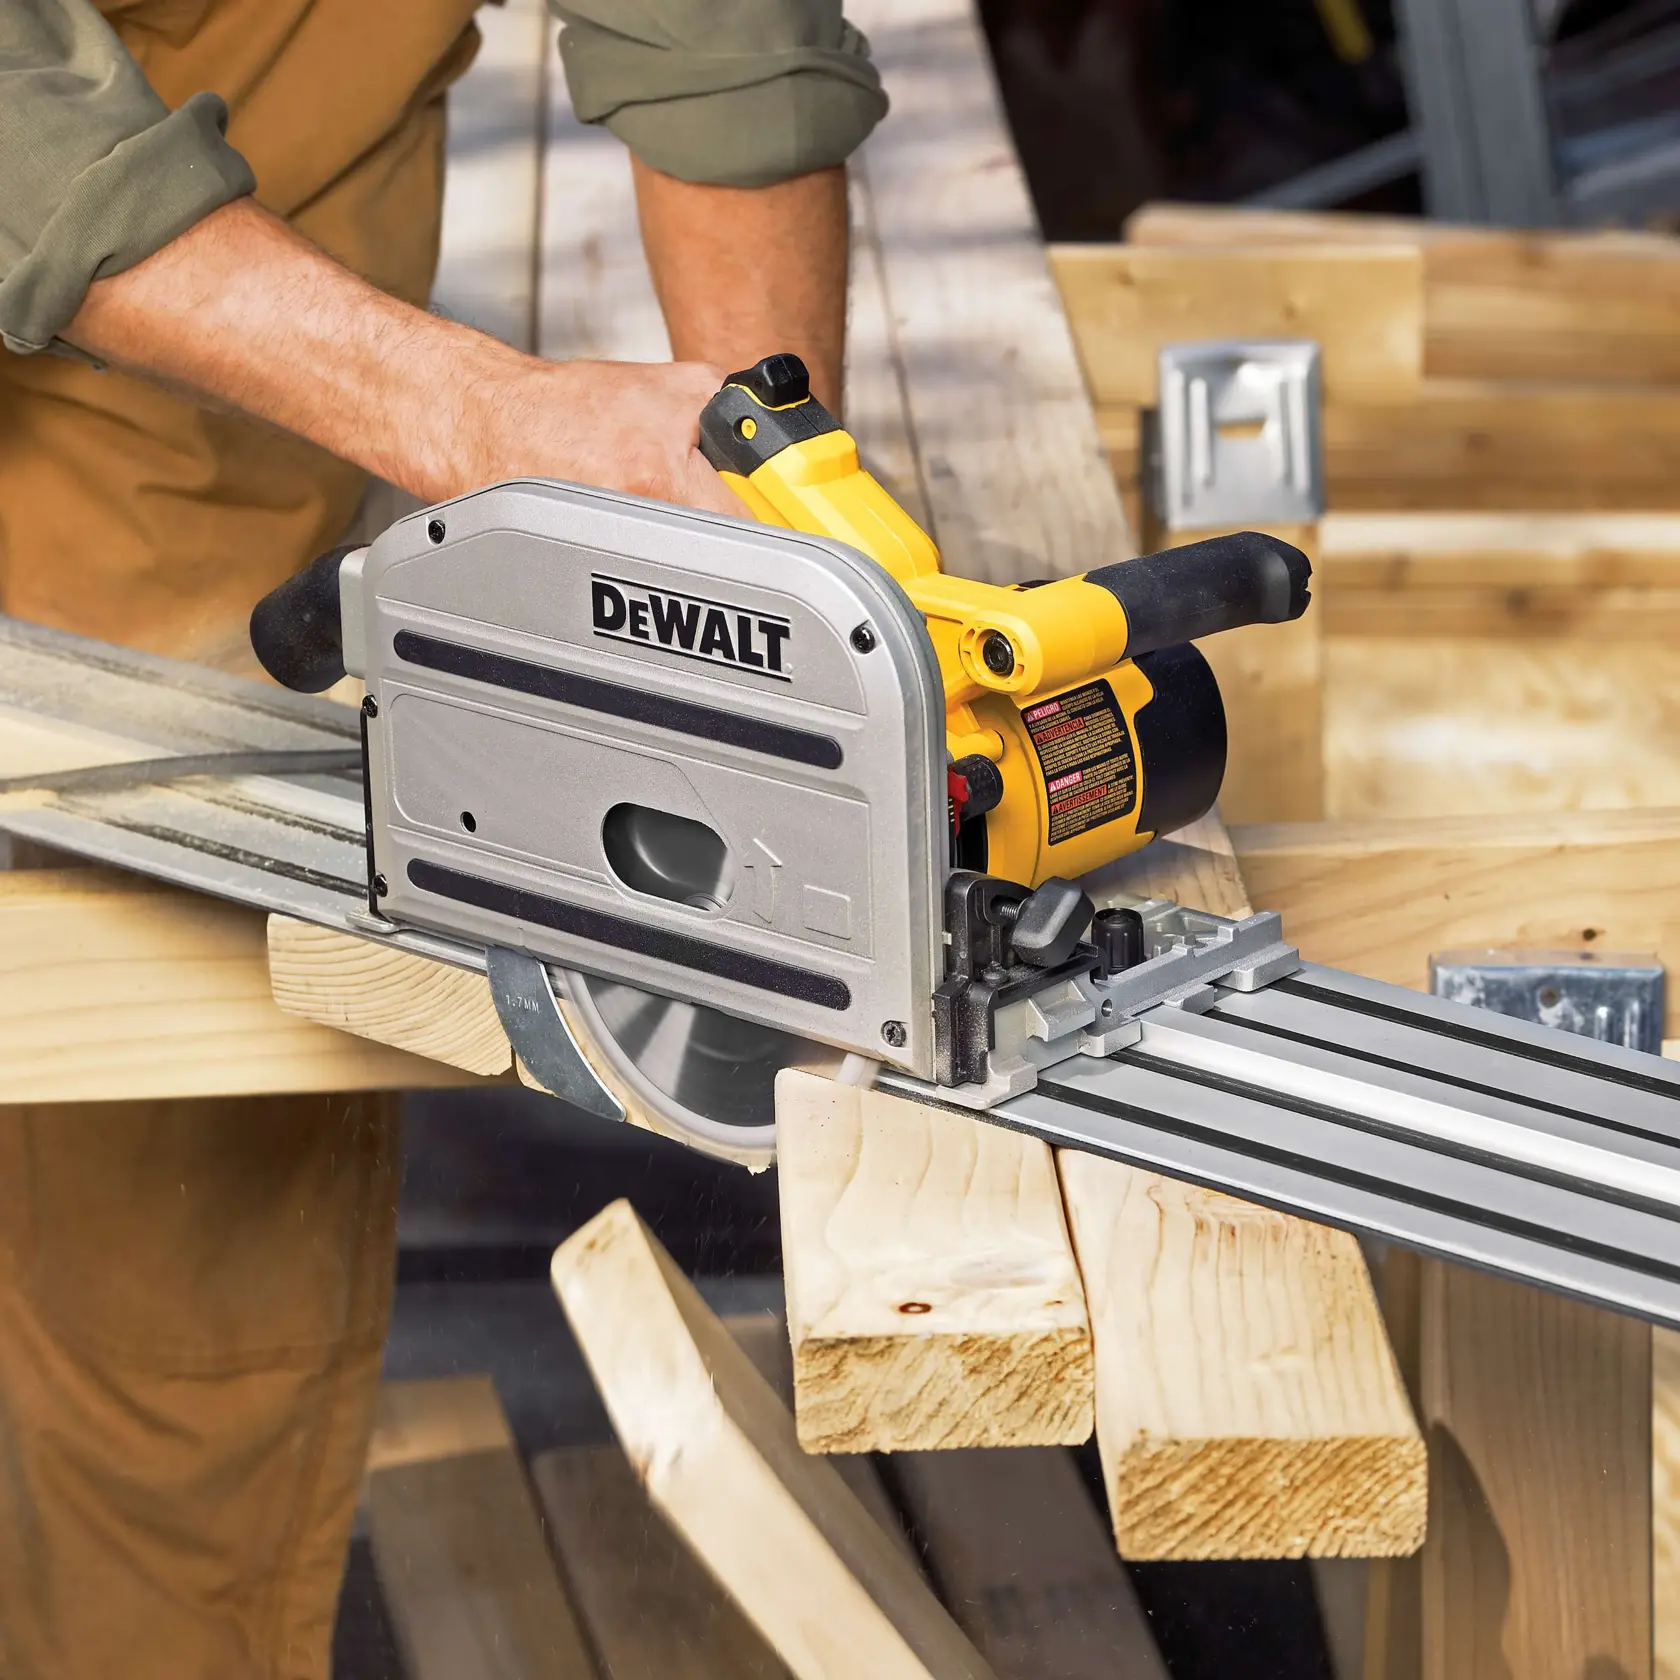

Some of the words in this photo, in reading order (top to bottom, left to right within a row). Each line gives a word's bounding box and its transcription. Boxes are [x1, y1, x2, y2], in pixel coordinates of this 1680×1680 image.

[592, 580, 791, 672] DEWALT
[1033, 702, 1059, 719] PELIGRO
[1043, 717, 1084, 742] ADVERTENCIA
[1055, 772, 1081, 790] DANGER
[1057, 786, 1106, 814] AVERTISSEMENT
